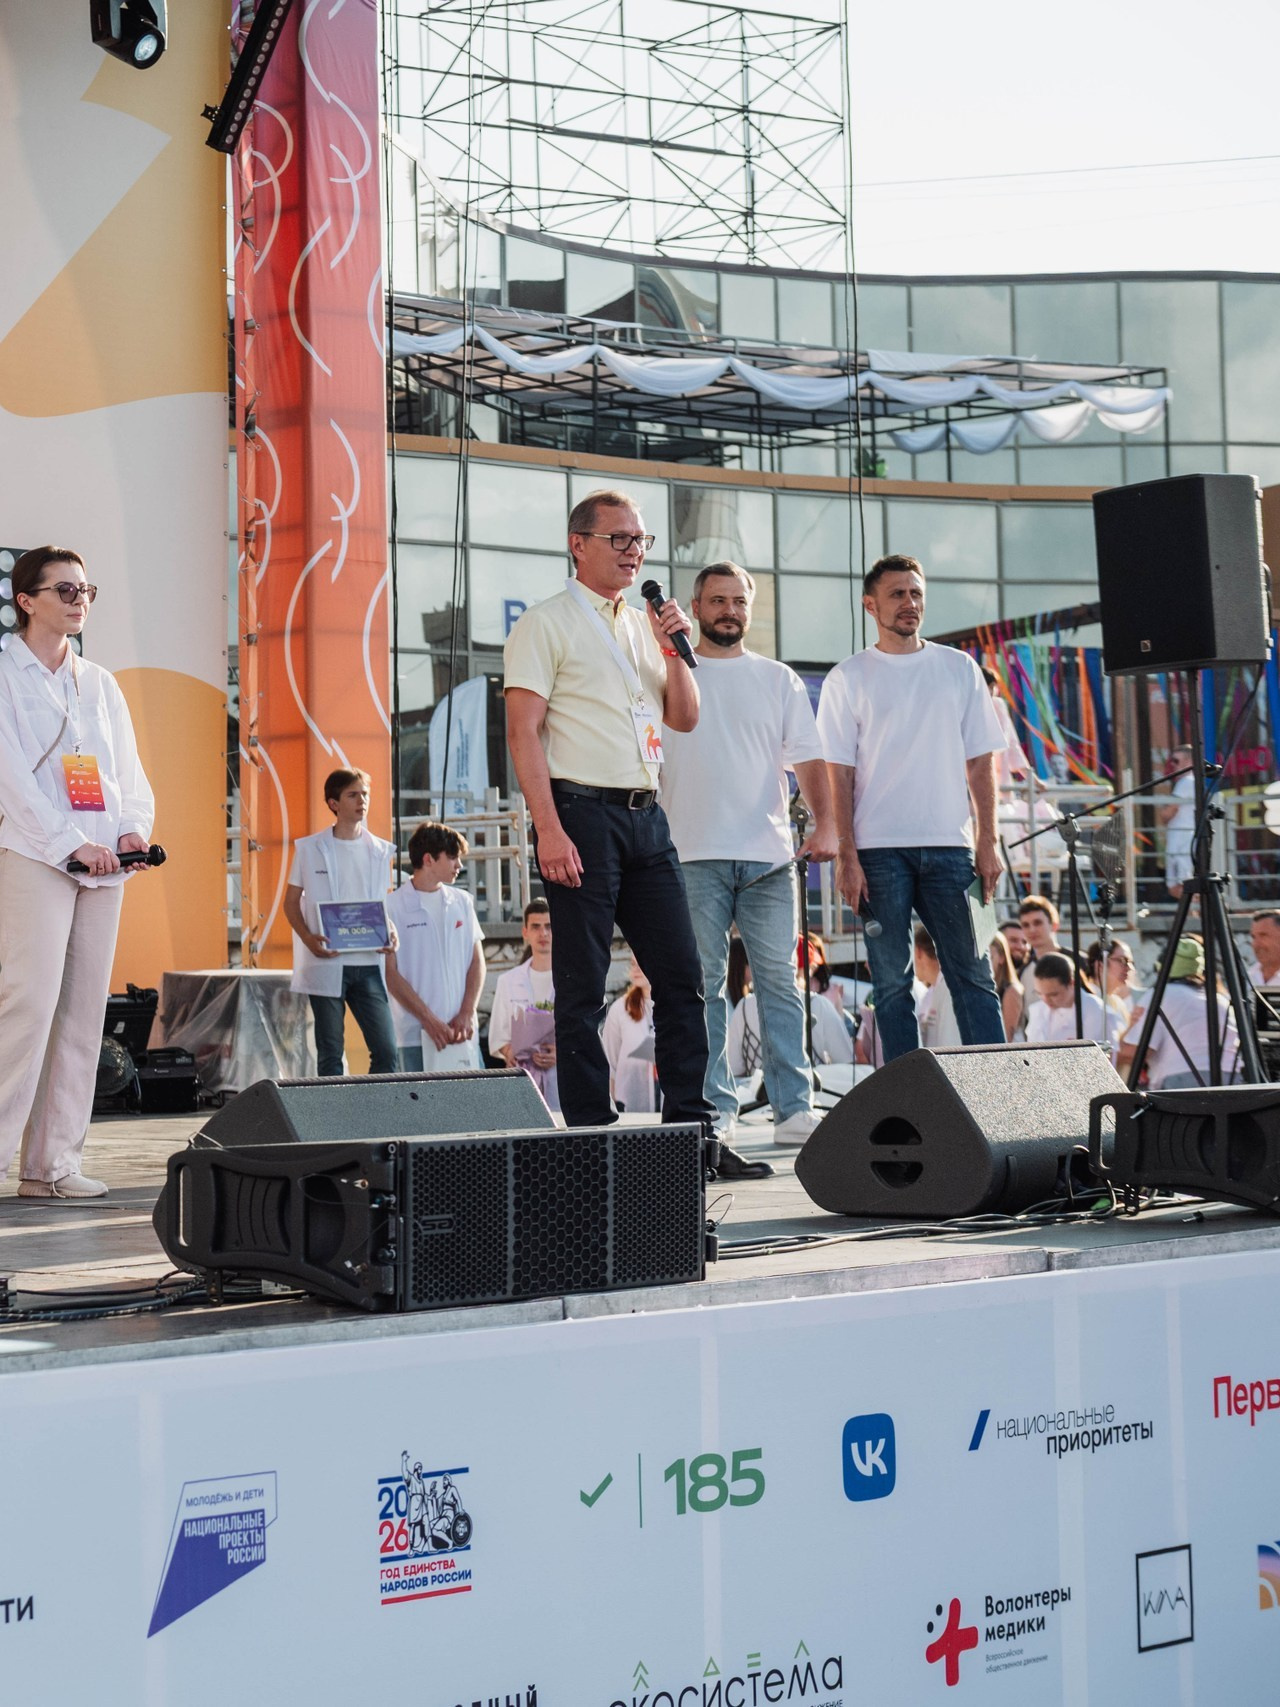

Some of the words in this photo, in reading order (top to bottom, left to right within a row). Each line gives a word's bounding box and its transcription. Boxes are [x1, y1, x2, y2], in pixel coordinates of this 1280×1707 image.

[1213, 1375, 1280, 1427] Перв
[996, 1404, 1115, 1440] национальные
[1046, 1420, 1154, 1459] приоритеты
[664, 1447, 766, 1515] 185
[185, 1492, 234, 1507] МОЛОДЁЖЬ
[235, 1491, 242, 1501] И
[243, 1488, 265, 1501] ДЕТИ
[378, 1484, 408, 1520] 20
[183, 1511, 264, 1538] НАЦИОНАЛЬНЫЕ
[219, 1528, 264, 1550] ПРОЕКТЫ
[378, 1518, 409, 1554] 26
[227, 1544, 265, 1565] РОССИИ
[380, 1567, 401, 1580] ГОД
[403, 1558, 456, 1577] ЕДИНСТВА
[380, 1576, 429, 1594] НАРОДОВ
[431, 1569, 472, 1586] РОССИИ
[984, 1586, 1072, 1617] Волонтеры
[984, 1615, 1046, 1642] медики
